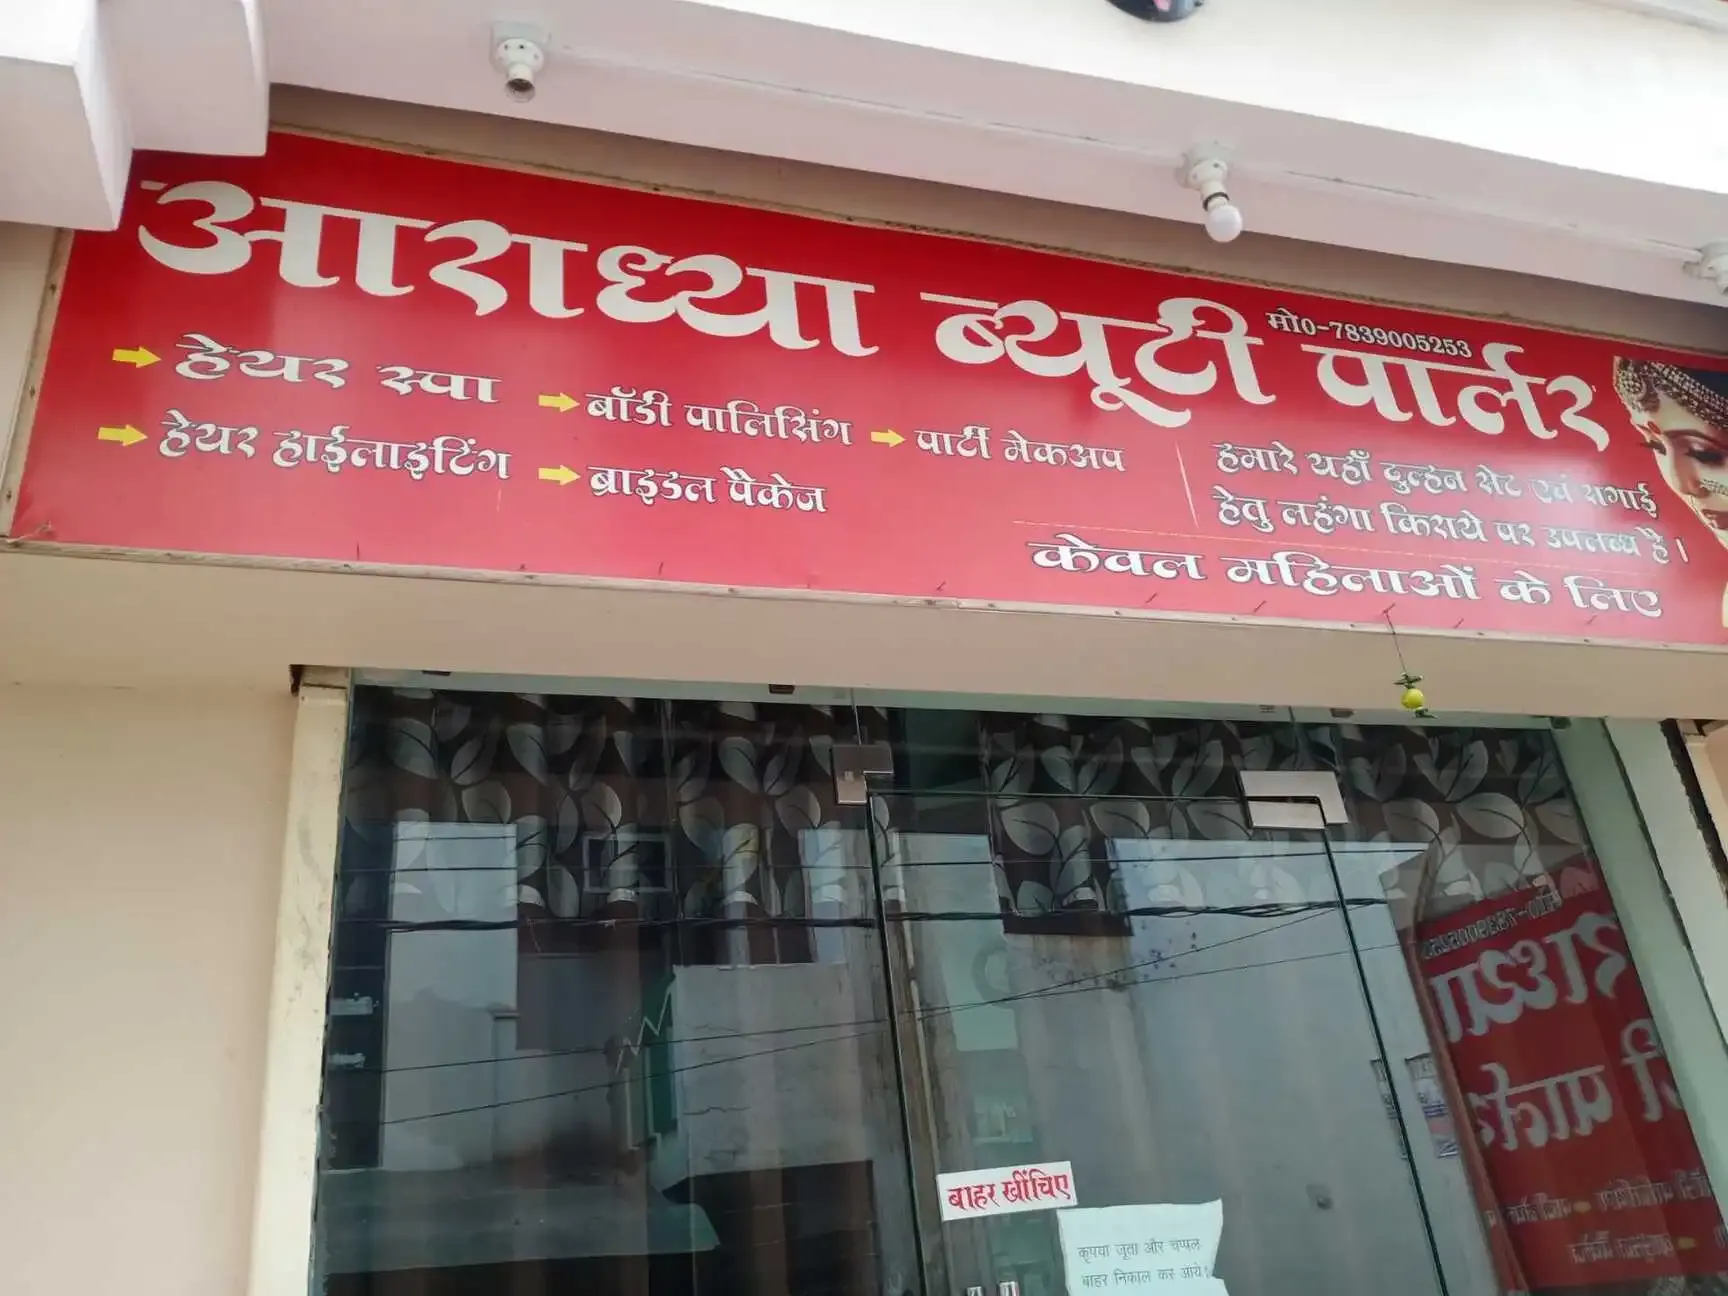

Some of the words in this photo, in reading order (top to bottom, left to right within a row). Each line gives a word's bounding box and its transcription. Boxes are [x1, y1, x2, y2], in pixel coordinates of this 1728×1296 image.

[138, 180, 879, 357] आराध्या
[919, 292, 1276, 426] ब्यूटी
[1301, 343, 1608, 452] पार्लर
[175, 332, 350, 390] हेयर
[376, 364, 503, 404] स्पा
[158, 408, 259, 460] हेयर
[272, 424, 514, 481] हाईलाइटिंग
[585, 385, 673, 427] बॉडी
[684, 399, 854, 446] पालिसिंग
[914, 425, 993, 461] पार्टी
[1000, 430, 1126, 473] मेकअप
[587, 465, 719, 506] ब्राइडल
[719, 465, 828, 514] पैकेज
[1211, 440, 1299, 475] हमारे
[1306, 449, 1374, 486] यहाँ
[1580, 480, 1658, 519] सगाई
[1212, 484, 1275, 534] हेतु
[1379, 501, 1489, 543] किराये
[1491, 520, 1536, 547] पर
[1539, 526, 1642, 557] उपलब्ध
[1027, 533, 1207, 580] केवल
[1219, 550, 1482, 601] महिलाओं
[1494, 569, 1553, 604] के
[1564, 574, 1663, 618] लिए
[946, 1182, 1001, 1212] बाहर
[1001, 1167, 1072, 1204] खींचिए
[1114, 1267, 1150, 1285] निकाल
